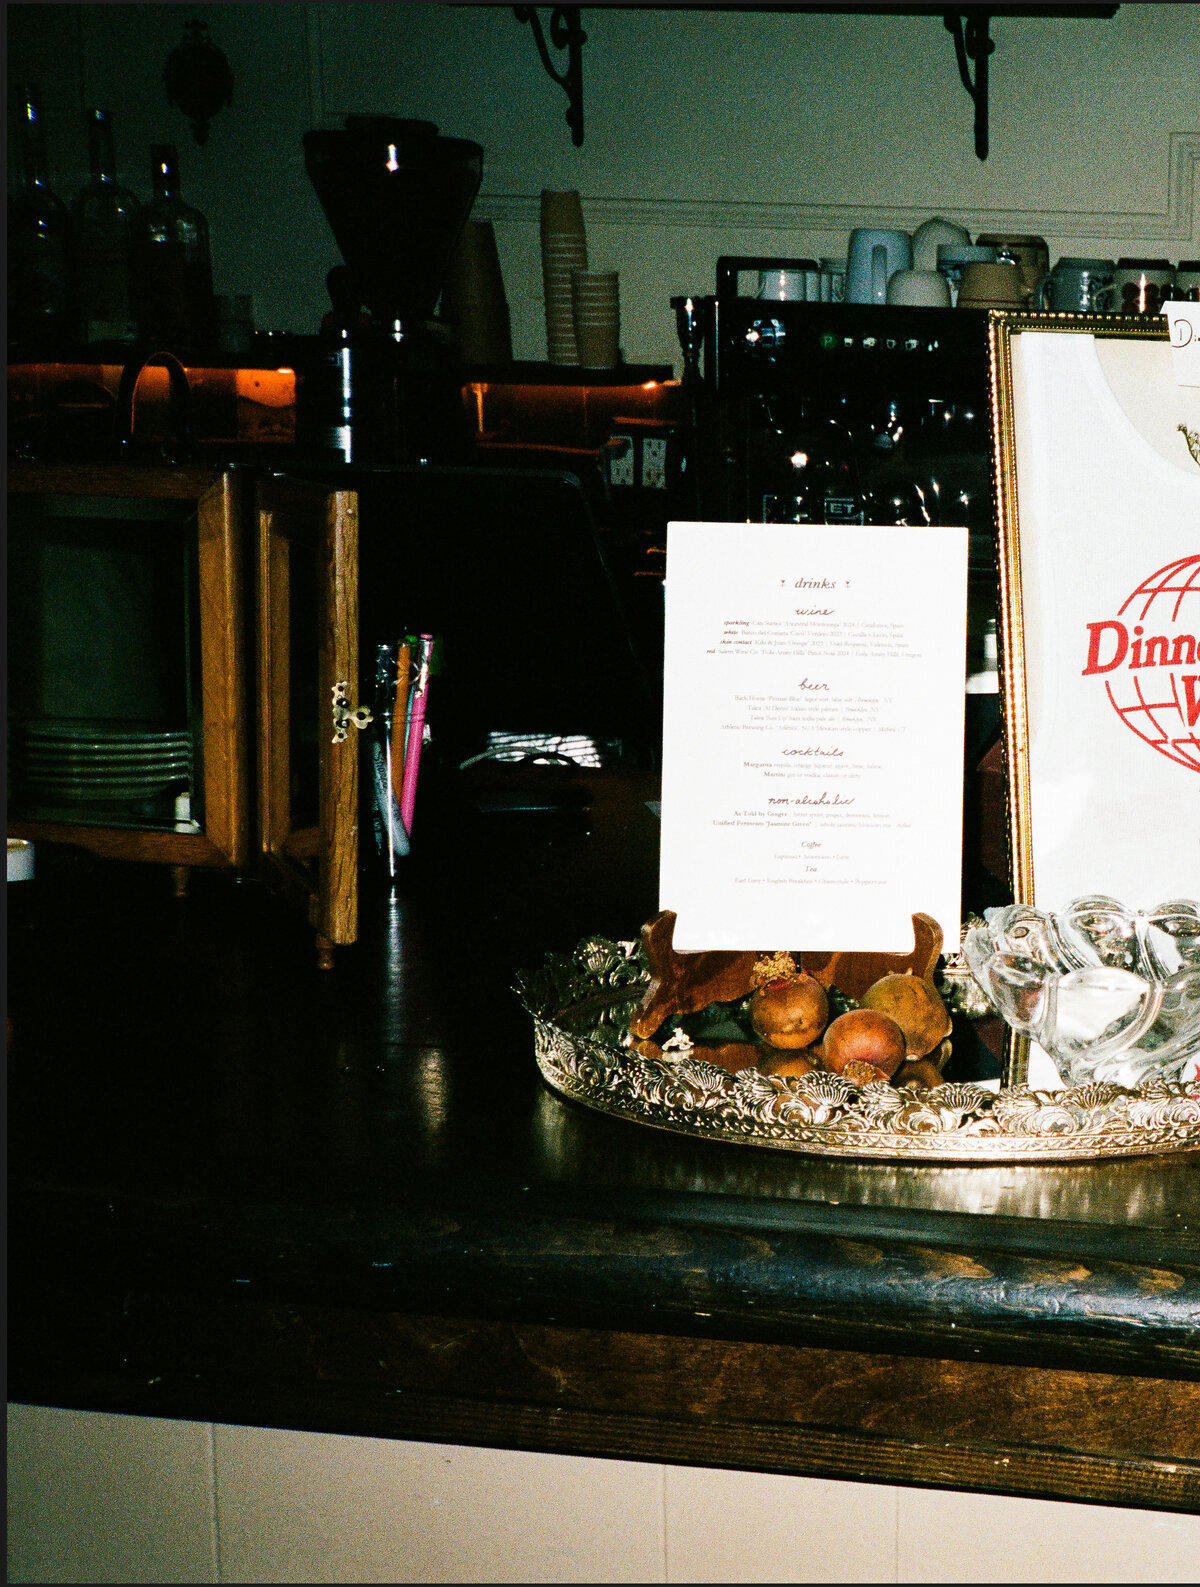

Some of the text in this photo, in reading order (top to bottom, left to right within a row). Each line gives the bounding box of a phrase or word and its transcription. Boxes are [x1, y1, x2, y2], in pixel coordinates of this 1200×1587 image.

[794, 577, 836, 590] drinks
[795, 604, 834, 615] wine
[798, 677, 829, 690] beer
[781, 746, 845, 757] cocktails
[768, 792, 855, 805] non-alcoholic
[800, 840, 822, 850] Coffee
[805, 865, 818, 873] Tea
